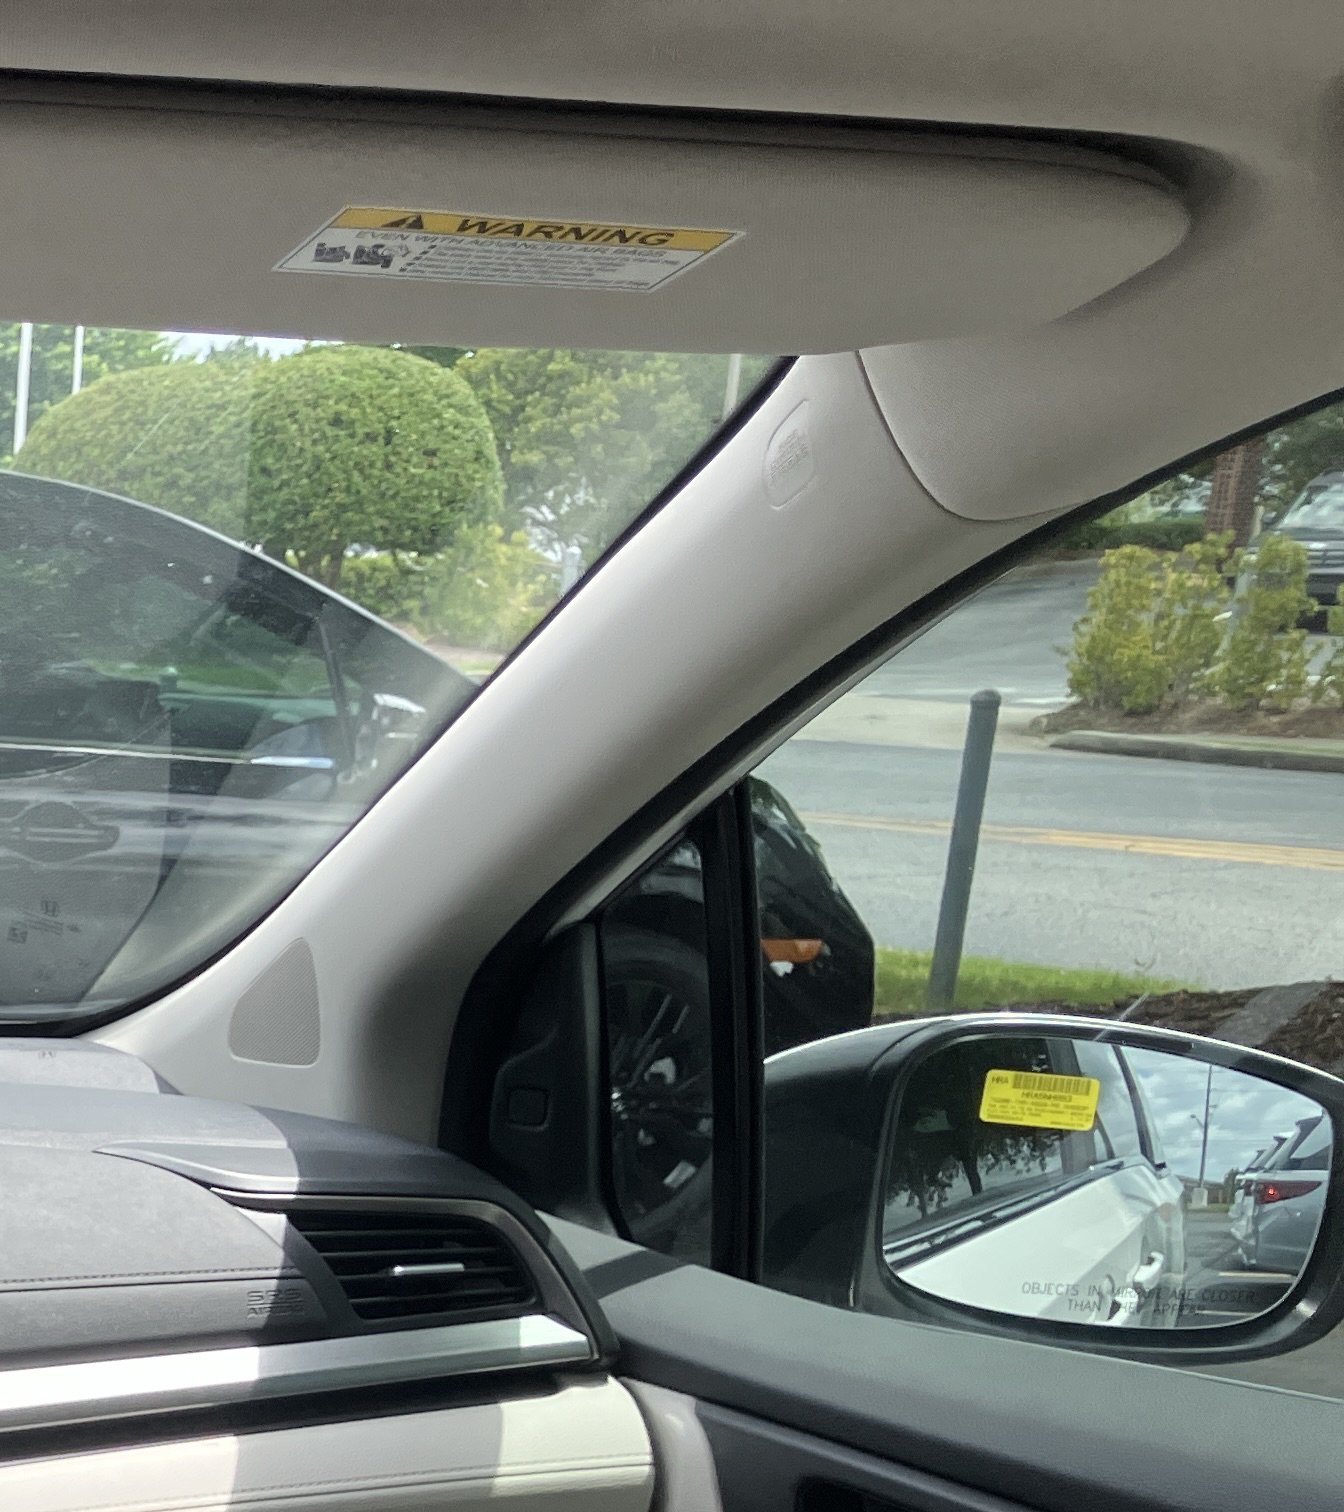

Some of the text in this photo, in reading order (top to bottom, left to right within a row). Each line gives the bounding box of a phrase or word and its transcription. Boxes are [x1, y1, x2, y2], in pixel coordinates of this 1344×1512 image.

[355, 231, 410, 241] EVEN
[415, 235, 464, 245] WITH
[457, 218, 674, 246] WARNING
[1021, 1281, 1080, 1297] OBJECTS
[1088, 1284, 1102, 1297] IN
[1201, 1288, 1256, 1305] CLOSER
[1067, 1297, 1102, 1313] THAN
